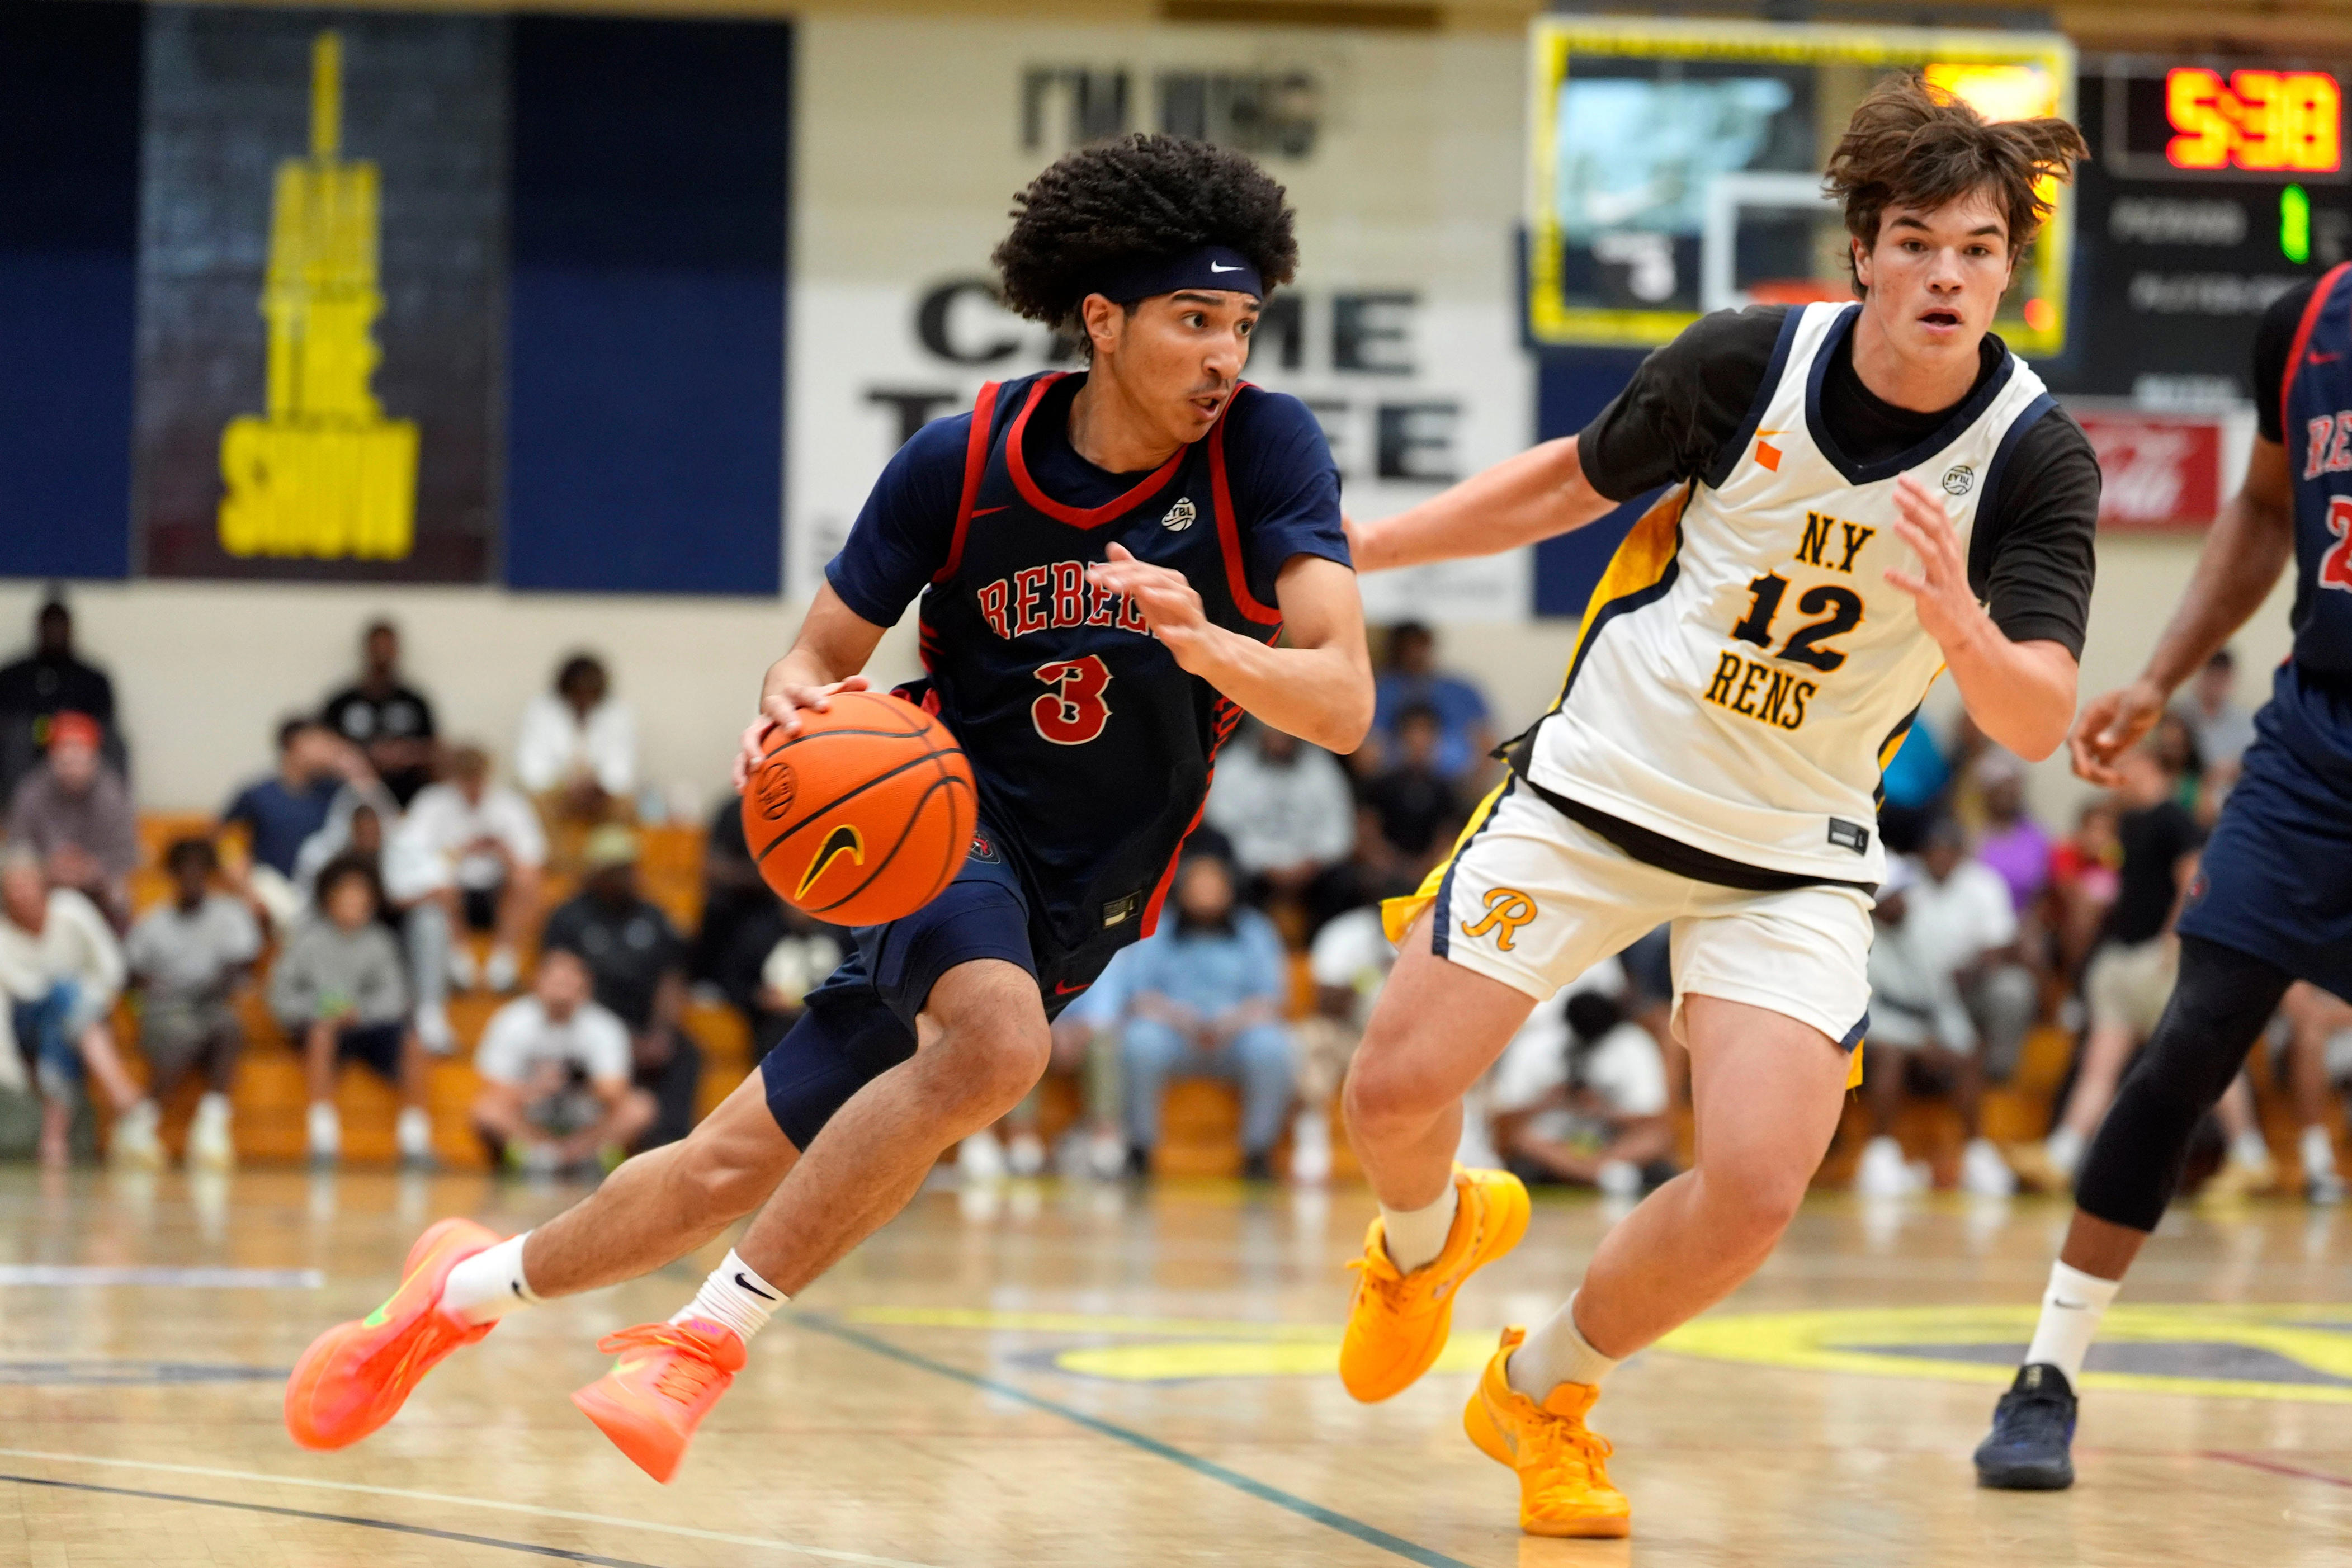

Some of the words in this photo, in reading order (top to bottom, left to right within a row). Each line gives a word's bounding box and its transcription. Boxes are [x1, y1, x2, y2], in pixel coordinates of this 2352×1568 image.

[2166, 68, 2341, 172] 5:38
[1795, 511, 1876, 574] N.Y
[977, 560, 1160, 640] REBEL
[1730, 569, 1865, 672] 12
[1031, 654, 1114, 745] 3
[1704, 650, 1820, 731] RENS
[1461, 887, 1538, 952] R
